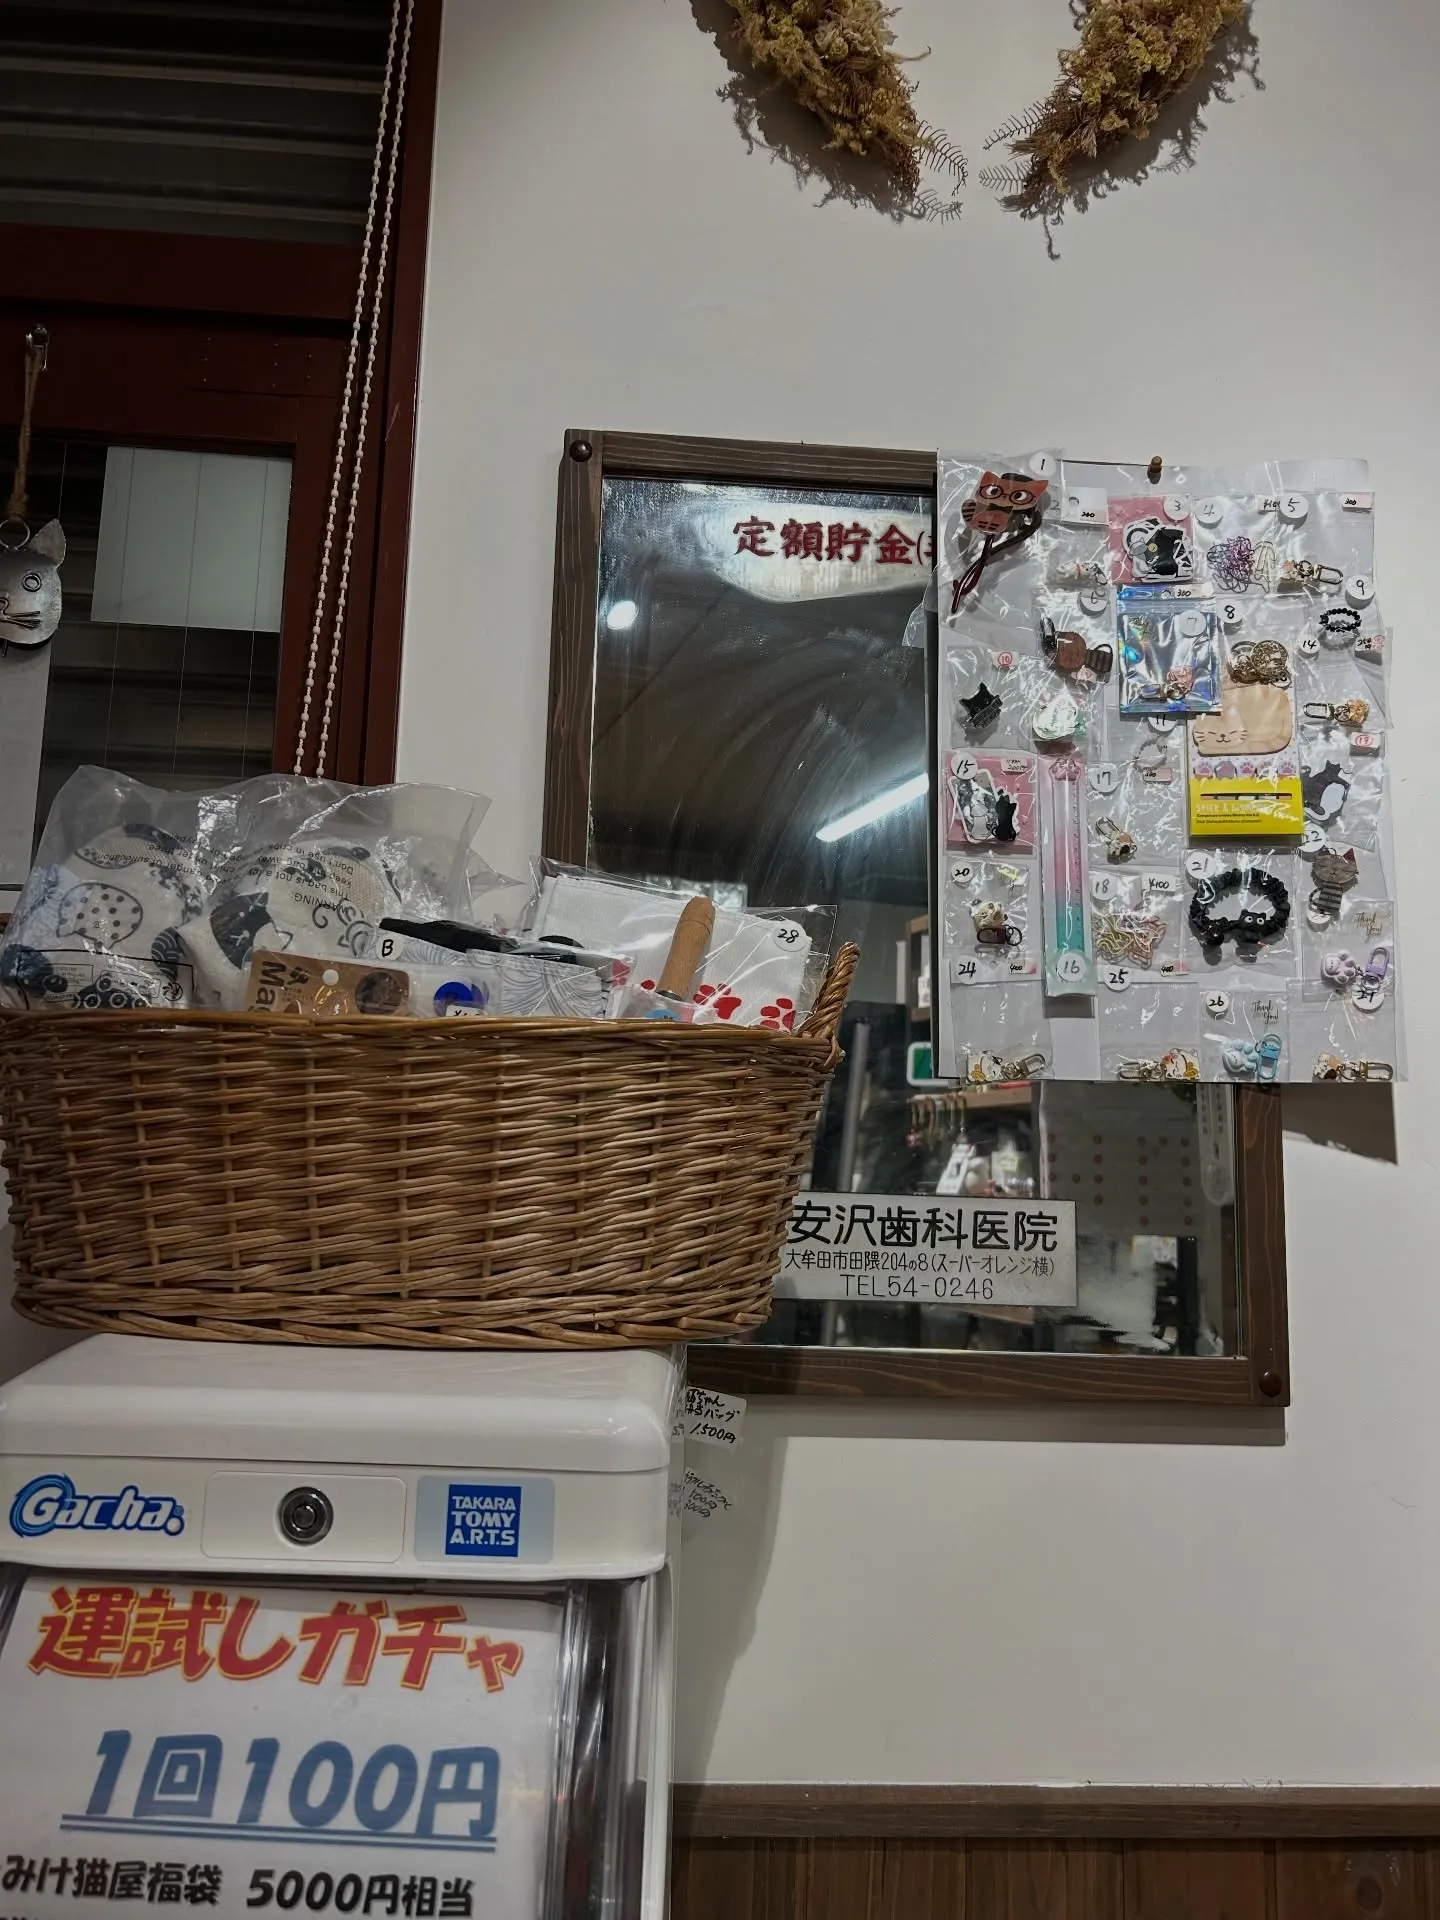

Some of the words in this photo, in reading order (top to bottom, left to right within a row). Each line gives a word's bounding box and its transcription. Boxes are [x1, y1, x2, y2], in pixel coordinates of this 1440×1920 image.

[1040, 458, 1046, 471] 1
[1050, 499, 1061, 511] 2
[1173, 500, 1181, 512] 3
[1203, 505, 1215, 516] 4
[1287, 498, 1300, 512] 5
[1176, 588, 1192, 597] 300
[1356, 579, 1365, 595] 9
[1225, 604, 1235, 619] 8
[1303, 640, 1317, 650] 14
[956, 760, 976, 776] 15
[1096, 772, 1111, 786] 17
[296, 848, 305, 856] in
[308, 851, 326, 863] use
[1192, 857, 1208, 872] 21
[276, 872, 293, 882] not
[954, 868, 970, 876] 20
[296, 877, 305, 887] is
[308, 880, 328, 892] bag
[1095, 878, 1110, 894] 18
[330, 887, 351, 902] This
[777, 928, 800, 944] 28
[382, 938, 394, 958] B
[958, 962, 977, 978] 24
[1010, 964, 1022, 972] 400
[1064, 960, 1080, 974] 16
[1160, 965, 1174, 973] 400
[1108, 969, 1129, 984] 25
[1208, 998, 1225, 1007] 26
[1357, 990, 1376, 1003] 27
[787, 1200, 1058, 1252] 安沢歯科医院
[452, 1496, 516, 1510] TAKARA
[451, 1511, 516, 1528] TOMY
[450, 1528, 516, 1546] A.R.T.S
[28, 1585, 523, 1693] 運試しガチャ
[85, 1729, 499, 1838] 1回100円
[2, 1855, 223, 1906] みけ猫屋福袋
[246, 1869, 476, 1918] 5000円相当
